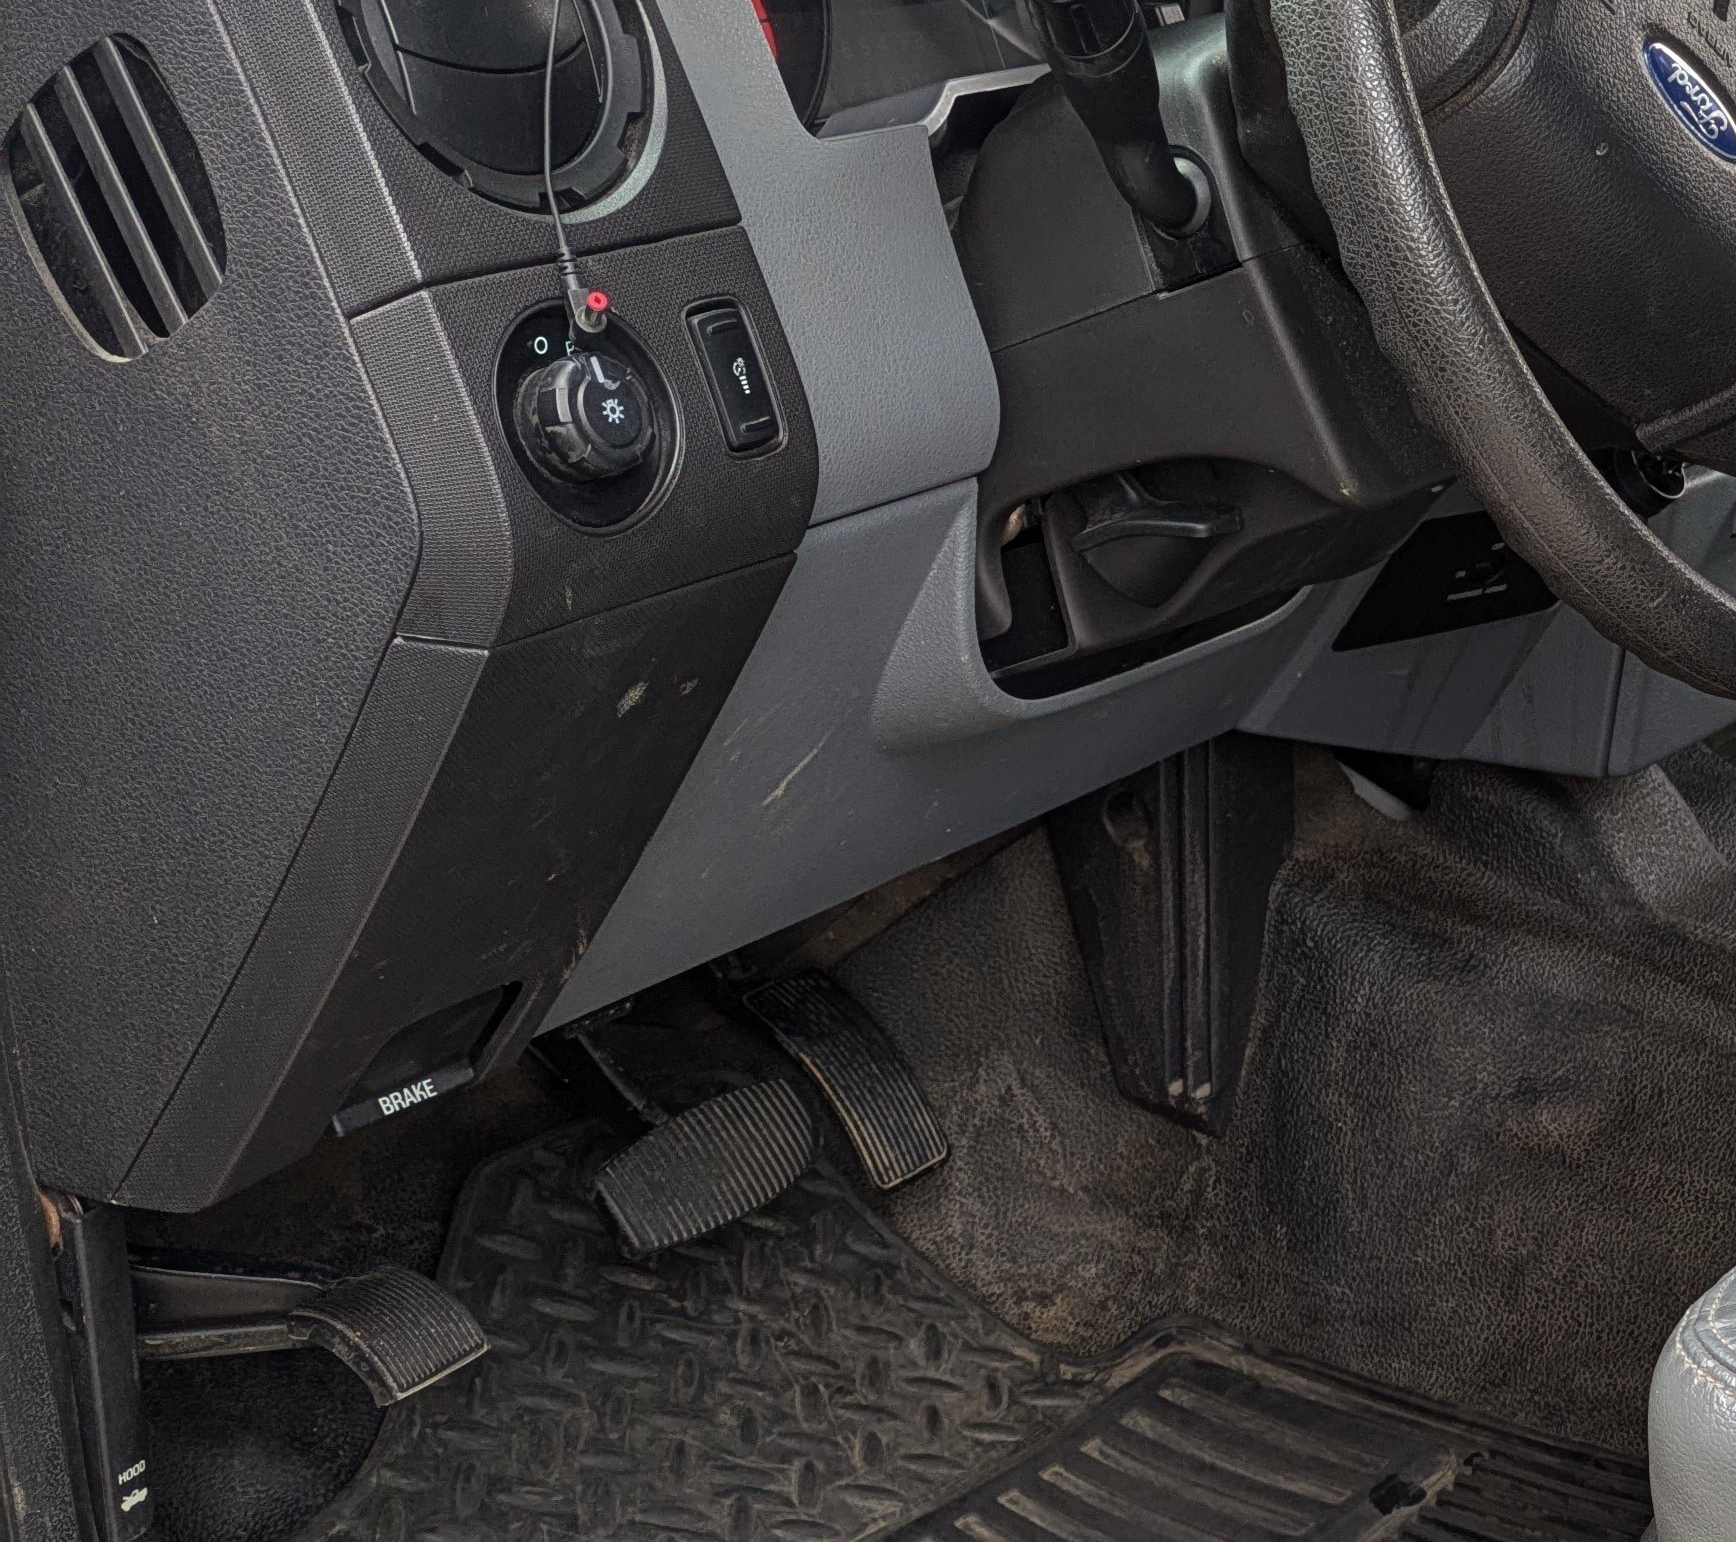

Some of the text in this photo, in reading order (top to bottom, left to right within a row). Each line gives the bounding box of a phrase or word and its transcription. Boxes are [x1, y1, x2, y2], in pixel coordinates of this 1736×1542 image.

[1667, 63, 1728, 139] Ford
[378, 1078, 438, 1115] BRAKE
[118, 1460, 146, 1486] HOOD
